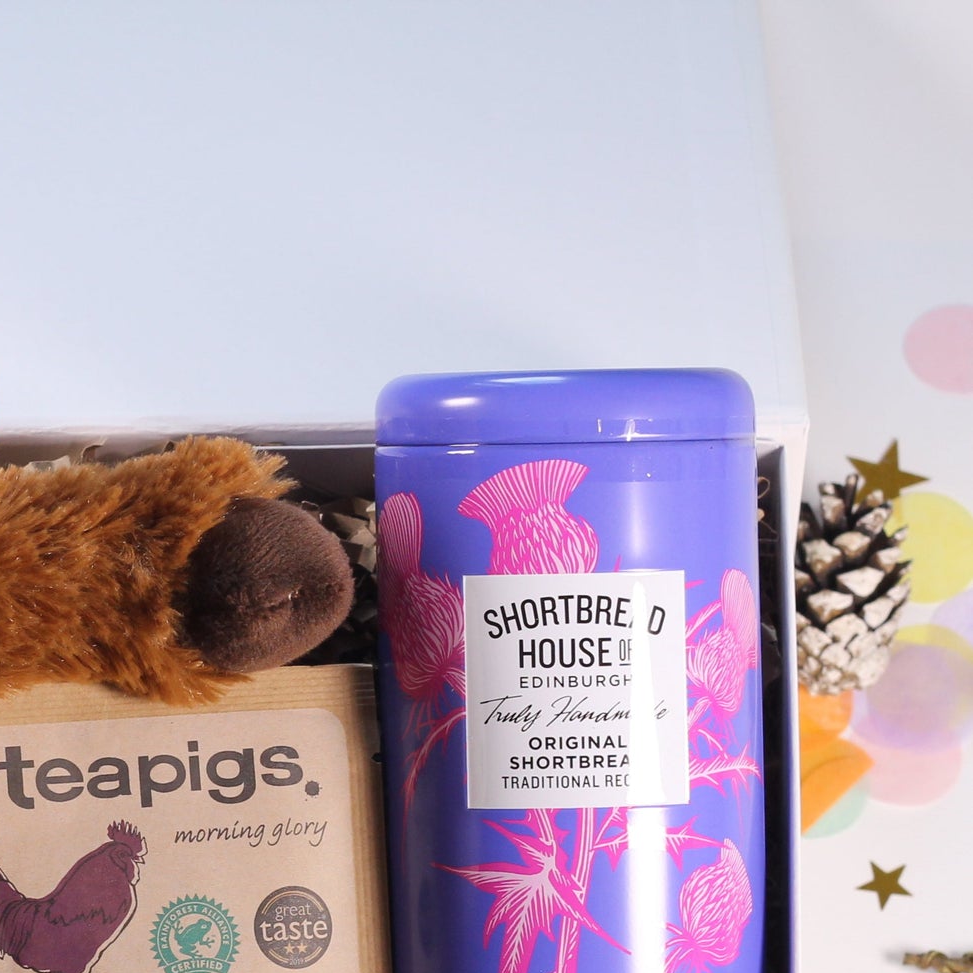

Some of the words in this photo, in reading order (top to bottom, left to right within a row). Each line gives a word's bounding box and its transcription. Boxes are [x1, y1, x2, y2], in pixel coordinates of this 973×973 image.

[483, 594, 666, 639] SHORTBRED
[518, 637, 612, 668] HOUSE
[480, 695, 543, 732] Truly
[546, 695, 669, 727] Handme
[528, 735, 627, 751] ORIGINAL
[509, 754, 630, 770] SHORTBREA
[502, 775, 599, 789] TRADITIONAL
[605, 774, 630, 788] REC
[174, 820, 265, 848] morning
[270, 817, 328, 848] glory
[275, 903, 312, 921] great
[160, 904, 199, 949] RAINFOREST
[201, 906, 230, 945] ALLIANCE
[259, 918, 328, 942] taste
[171, 960, 224, 973] CERTIFIED
